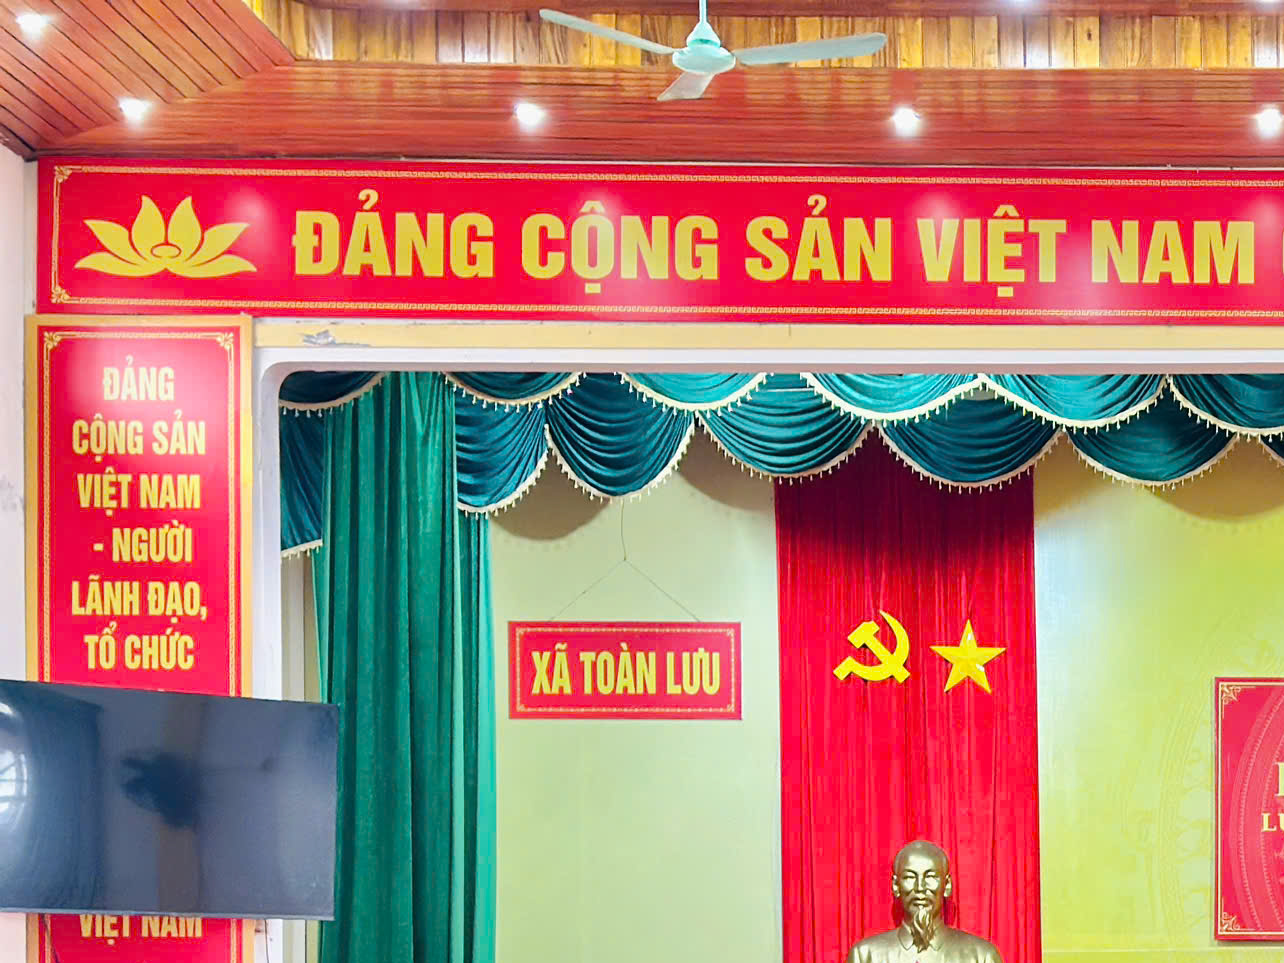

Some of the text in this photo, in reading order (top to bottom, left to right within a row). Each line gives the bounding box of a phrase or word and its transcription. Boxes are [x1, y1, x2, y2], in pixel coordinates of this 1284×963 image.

[292, 189, 494, 279] ĐẢNG
[521, 201, 719, 294] CỘNG
[745, 194, 893, 282] SẢN
[917, 205, 1067, 297] VIỆT
[1091, 219, 1255, 285] NAM
[102, 355, 175, 401] ĐẢNG
[72, 409, 206, 462] CỘNG SẢN
[77, 466, 201, 516] VIỆT NAM
[112, 519, 193, 563] NGƯỜI
[71, 574, 208, 624] LÃNH ĐẠO,
[84, 621, 195, 671] TỔ CHỨC
[531, 642, 720, 695] XÃ TOÀN LƯU
